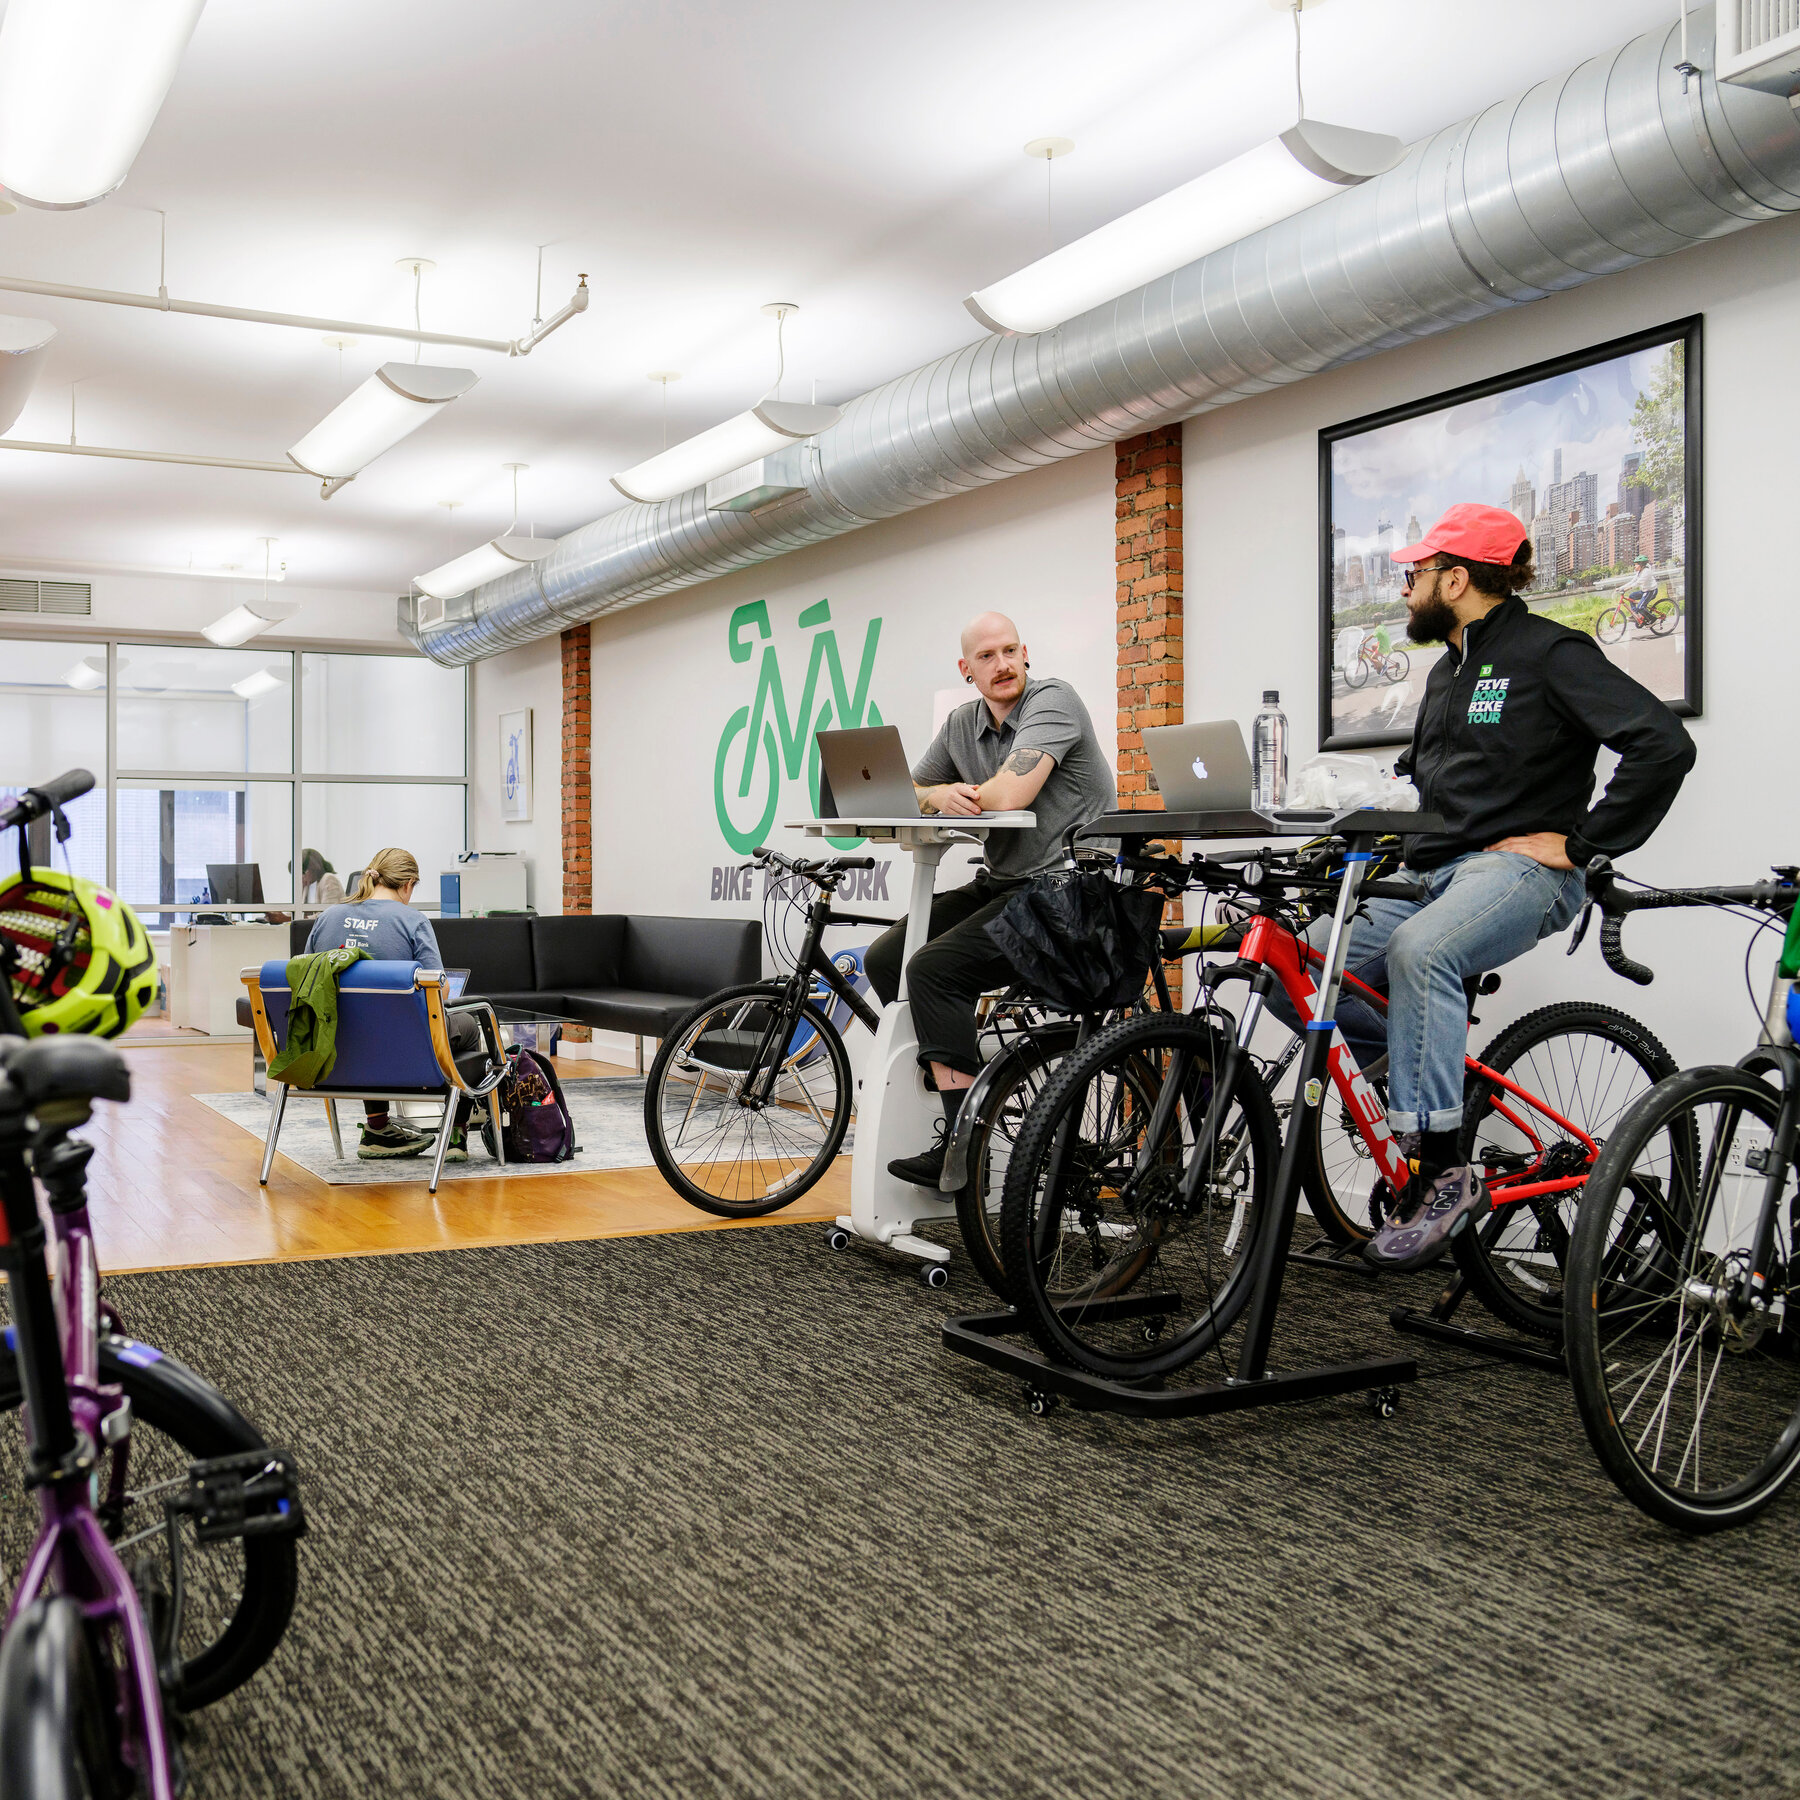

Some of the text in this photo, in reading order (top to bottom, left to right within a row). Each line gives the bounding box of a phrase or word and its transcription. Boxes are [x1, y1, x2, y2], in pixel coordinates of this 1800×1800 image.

[1475, 678, 1510, 690] FIVE
[1472, 690, 1507, 701] BORO
[1468, 701, 1504, 712] BIKE
[1467, 712, 1501, 724] TOUR
[710, 865, 753, 901] BIKE
[832, 861, 892, 902] ORK
[343, 917, 379, 930] STAFF
[1607, 1024, 1660, 1060] XR2 COMP
